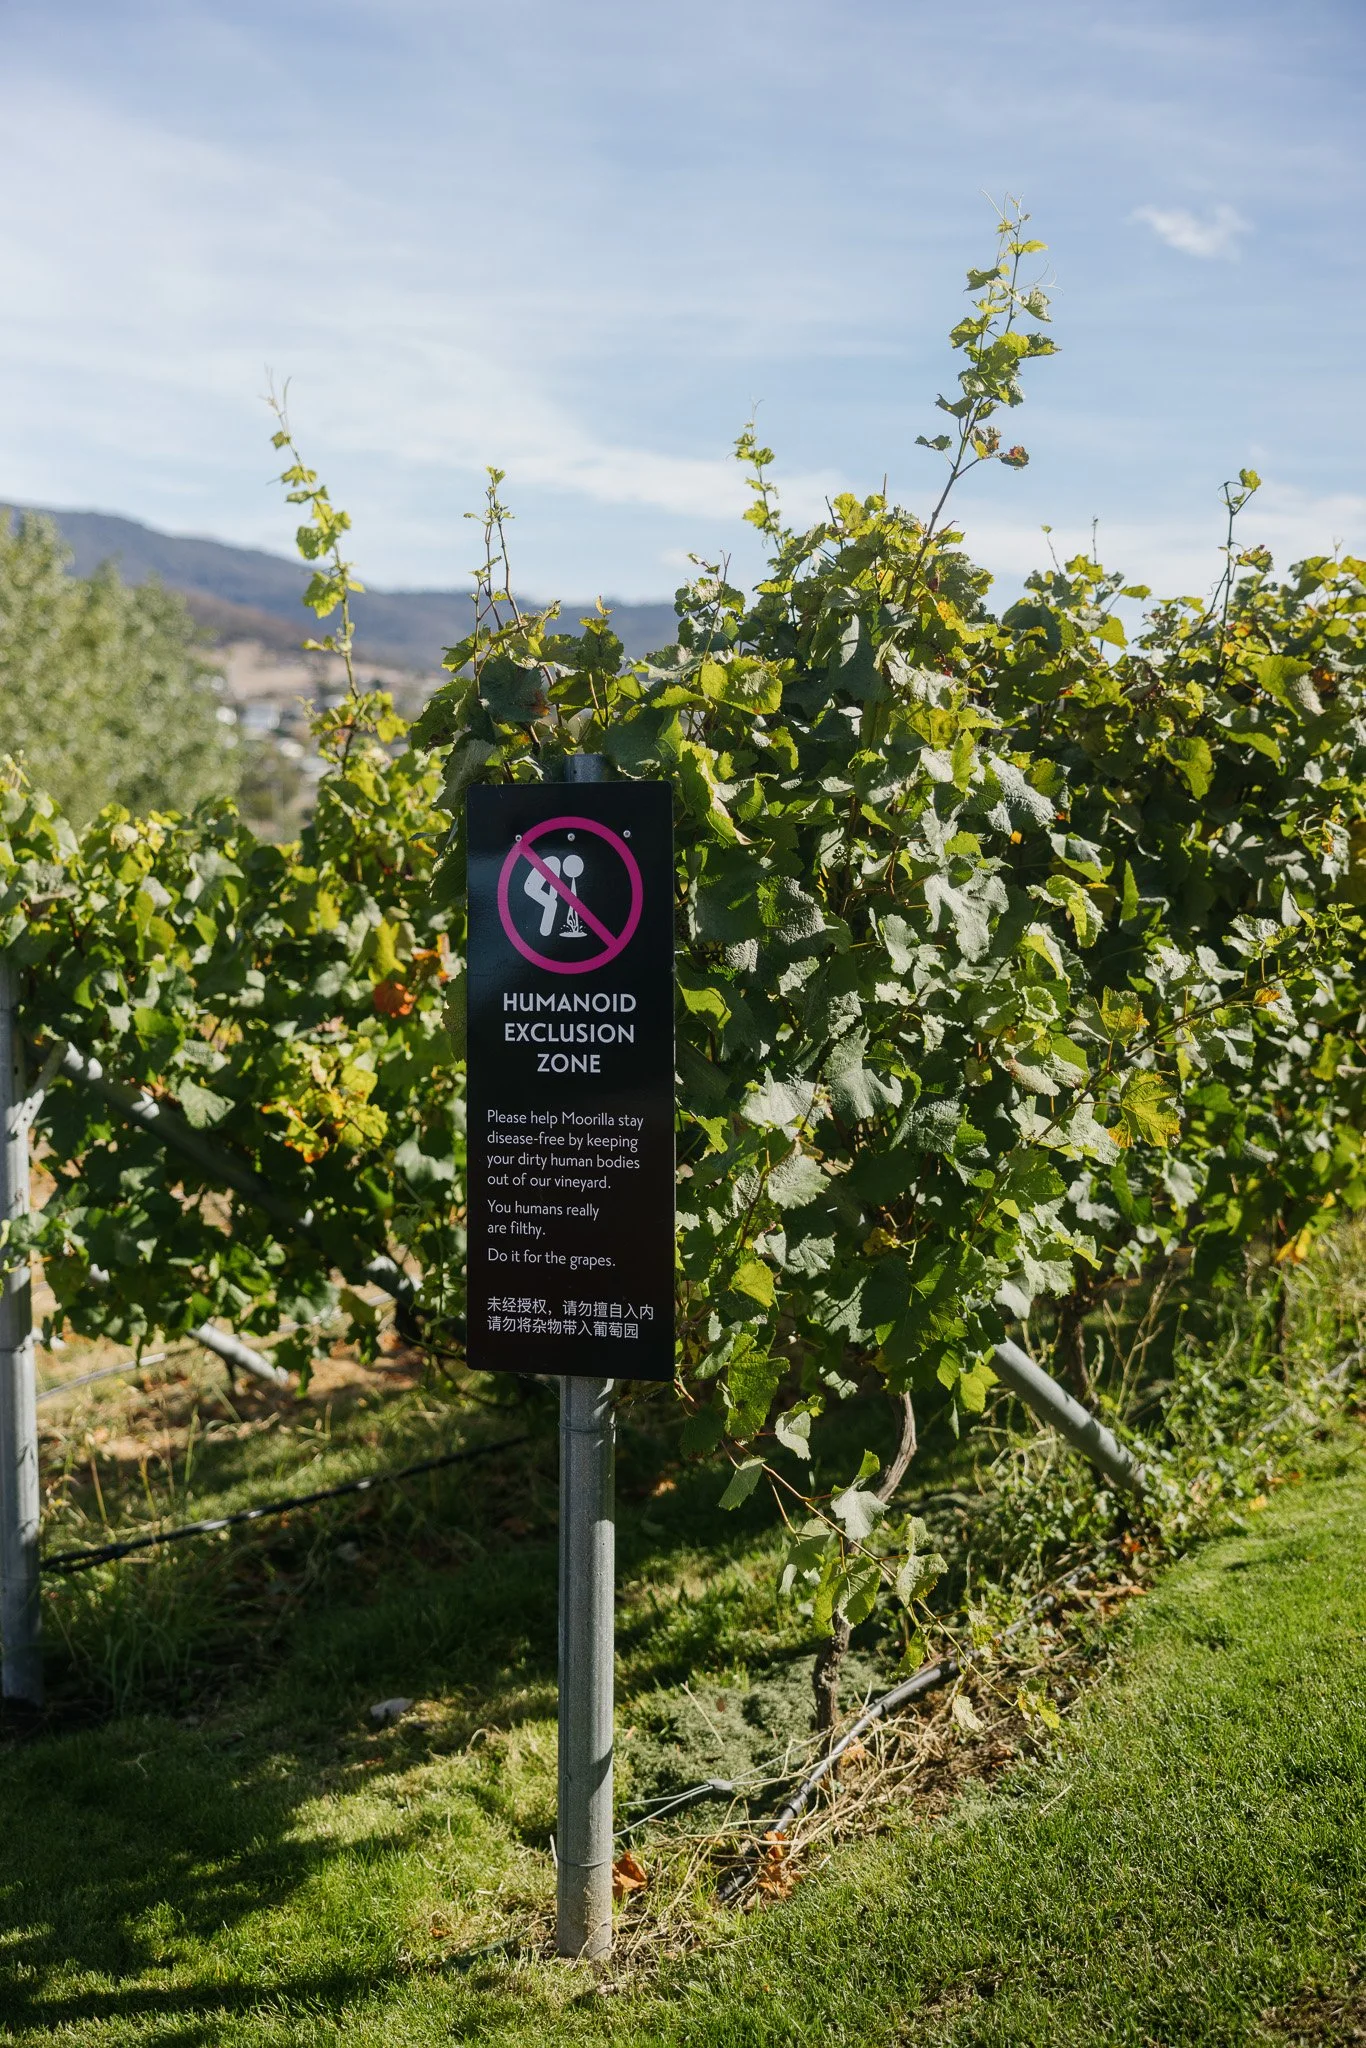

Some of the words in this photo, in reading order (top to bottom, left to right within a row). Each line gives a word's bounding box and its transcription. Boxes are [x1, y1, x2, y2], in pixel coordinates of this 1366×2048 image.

[504, 993, 636, 1012] HUMANOID
[505, 1023, 634, 1043] EXCLUSION
[537, 1054, 600, 1073] ZONE
[488, 1110, 526, 1123] Please
[531, 1111, 557, 1128] help
[562, 1112, 614, 1125] Moorilla
[618, 1114, 643, 1131] stay
[487, 1131, 564, 1145] disease-free
[569, 1133, 583, 1150] by
[587, 1133, 638, 1152] keeping
[487, 1154, 514, 1168] your
[518, 1152, 547, 1170] dirty
[551, 1153, 592, 1167] human
[597, 1155, 639, 1168] bodies
[487, 1174, 509, 1186] out
[513, 1172, 527, 1186] of
[530, 1177, 551, 1187] our
[555, 1176, 610, 1192] vineyard.
[487, 1200, 511, 1214] You
[515, 1201, 562, 1215] humans
[567, 1203, 599, 1221] really
[487, 1224, 507, 1234] are
[511, 1221, 545, 1239] filthy.
[488, 1247, 508, 1262] Do
[511, 1250, 520, 1263] it
[524, 1249, 542, 1263] for
[545, 1251, 566, 1264] the
[570, 1255, 616, 1271] grapes.
